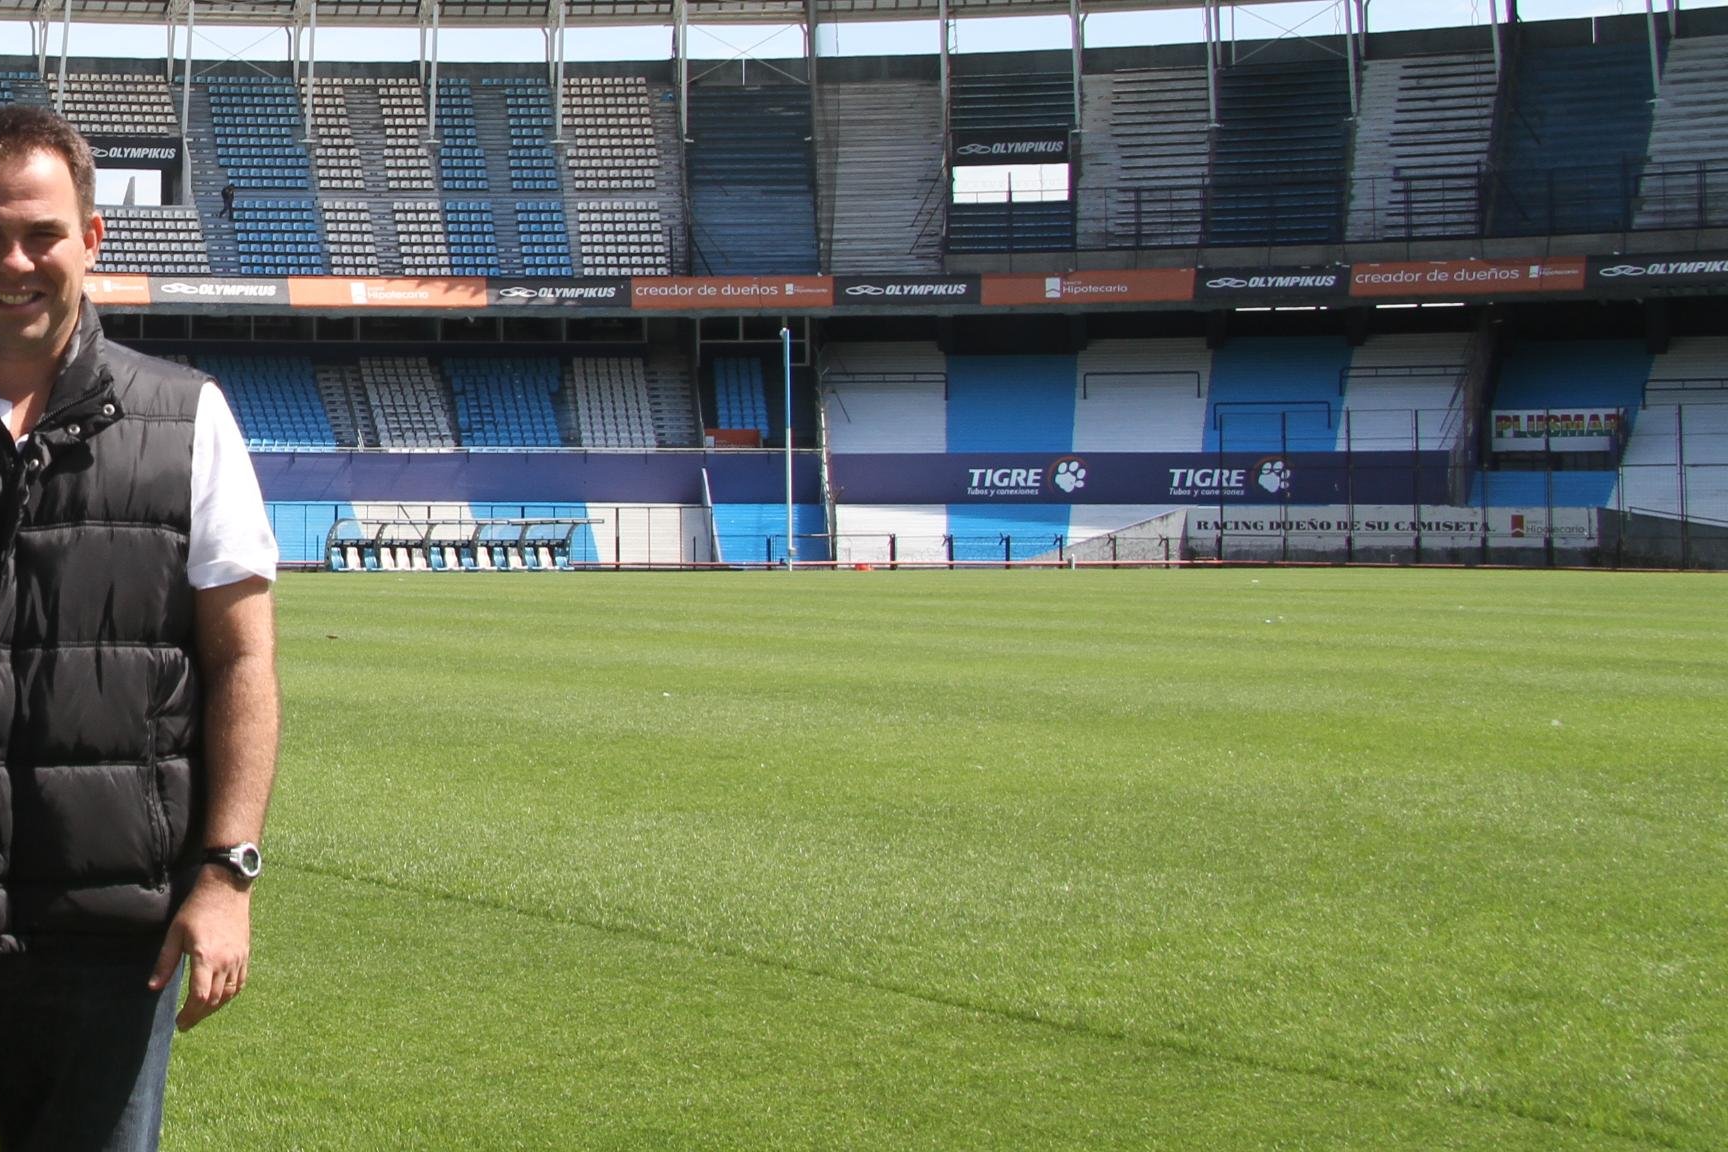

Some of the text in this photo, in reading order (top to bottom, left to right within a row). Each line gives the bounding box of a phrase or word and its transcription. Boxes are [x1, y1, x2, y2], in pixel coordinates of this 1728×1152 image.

[109, 147, 176, 159] OLYMPIKUS
[992, 141, 1064, 154] OLYMPIKUS
[1248, 275, 1336, 288] OLYMPIKUS
[1355, 271, 1422, 284] creador
[1426, 269, 1448, 281] de
[1452, 267, 1520, 281] dueños
[199, 284, 277, 297] OLYMPIKUS
[538, 287, 616, 298] OLYMPIKUS
[635, 285, 693, 296] creador
[697, 284, 717, 296] de
[721, 283, 778, 296] dueños
[885, 284, 967, 296] OLYMPIKUS
[1062, 285, 1128, 294] Hipotecario
[969, 468, 1043, 487] TIGRE
[1169, 468, 1247, 487] TIGRE
[1196, 520, 1264, 531] RACING
[1269, 518, 1331, 531] DUEÑO
[1365, 520, 1389, 531] SU
